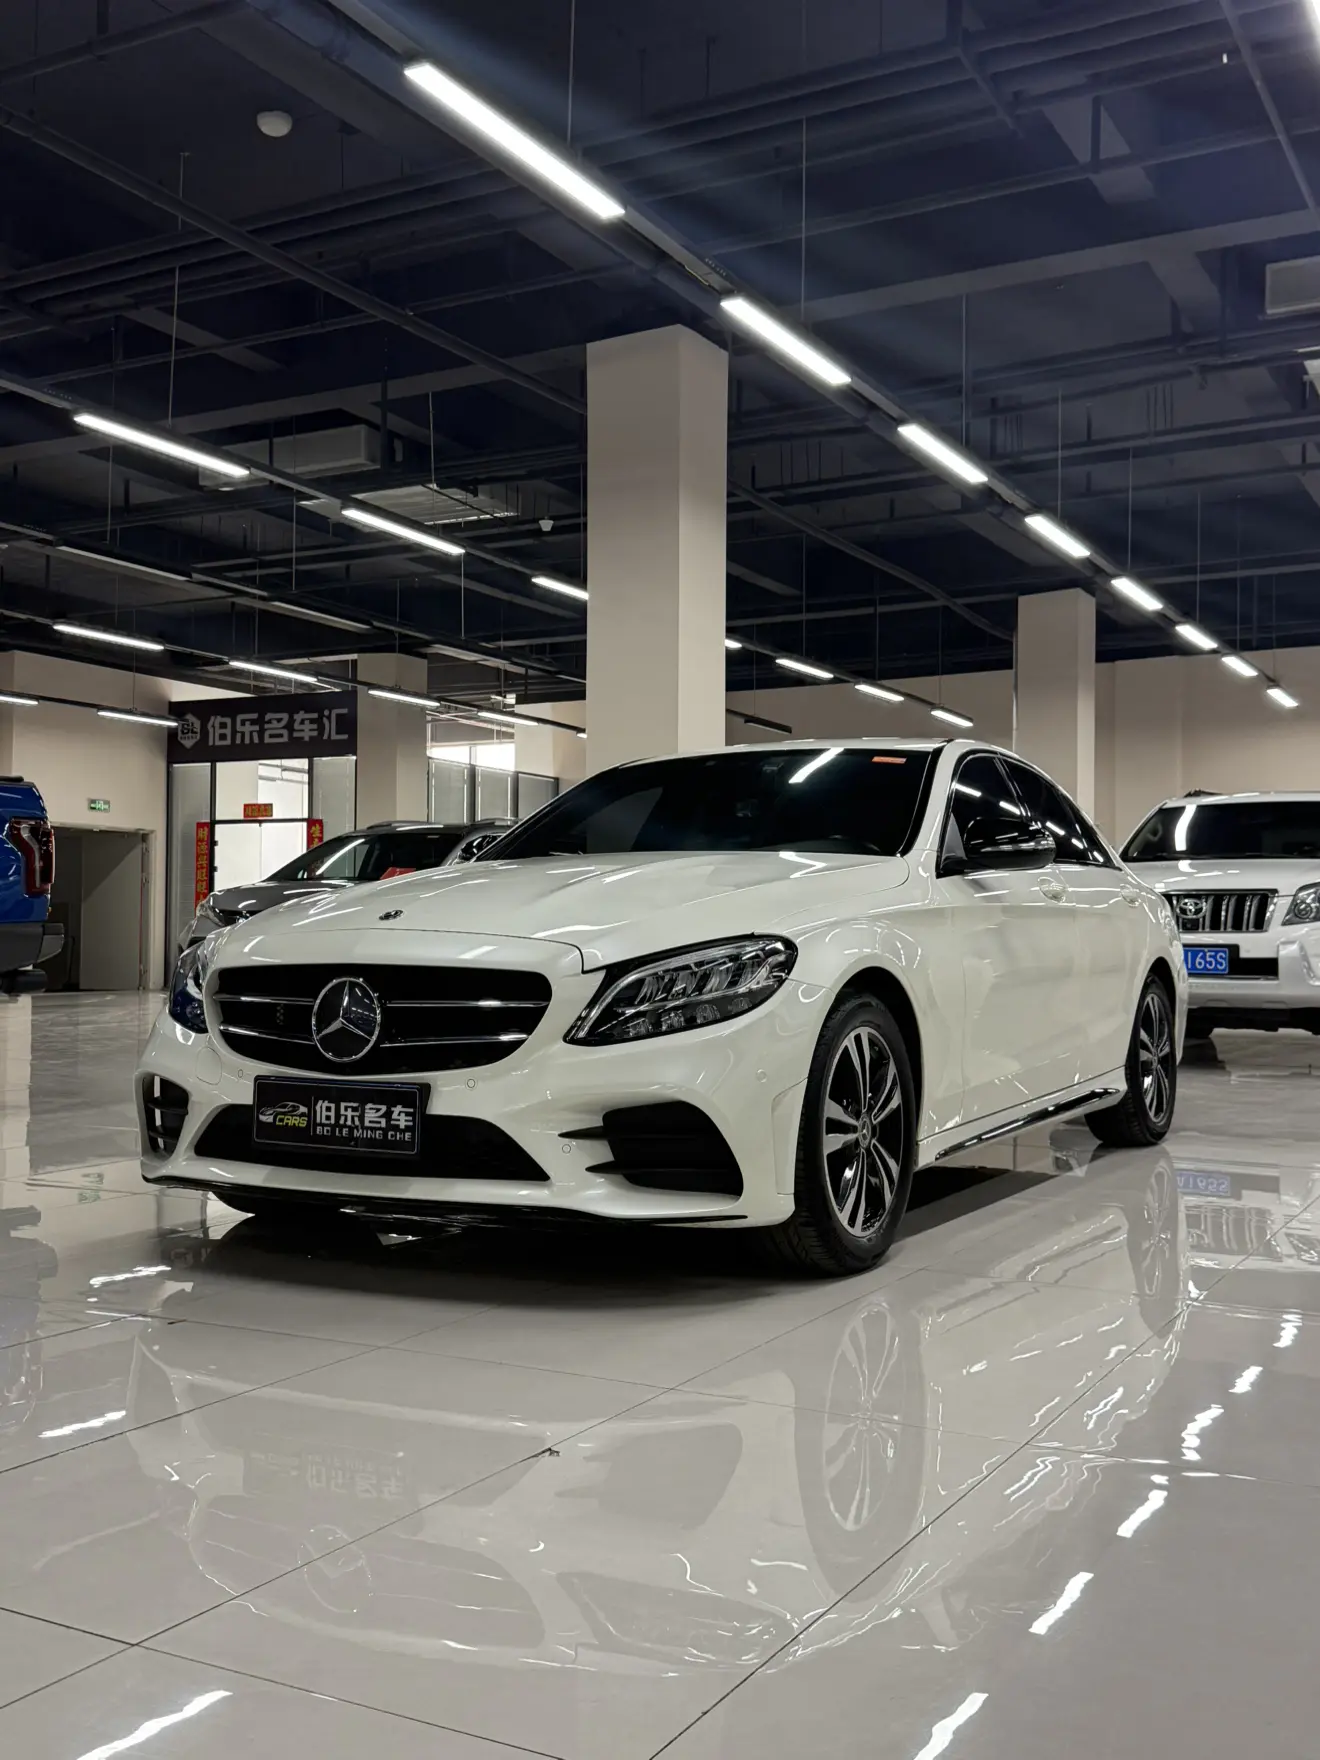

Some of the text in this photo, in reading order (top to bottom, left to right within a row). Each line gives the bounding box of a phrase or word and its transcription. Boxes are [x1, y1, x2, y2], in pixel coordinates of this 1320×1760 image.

[207, 708, 349, 746] 伯乐名车汇
[1187, 951, 1227, 970] 165S
[275, 1114, 308, 1128] CARS
[315, 1100, 414, 1129] 伯乐名车
[316, 1126, 412, 1142] BO LE MING CHE
